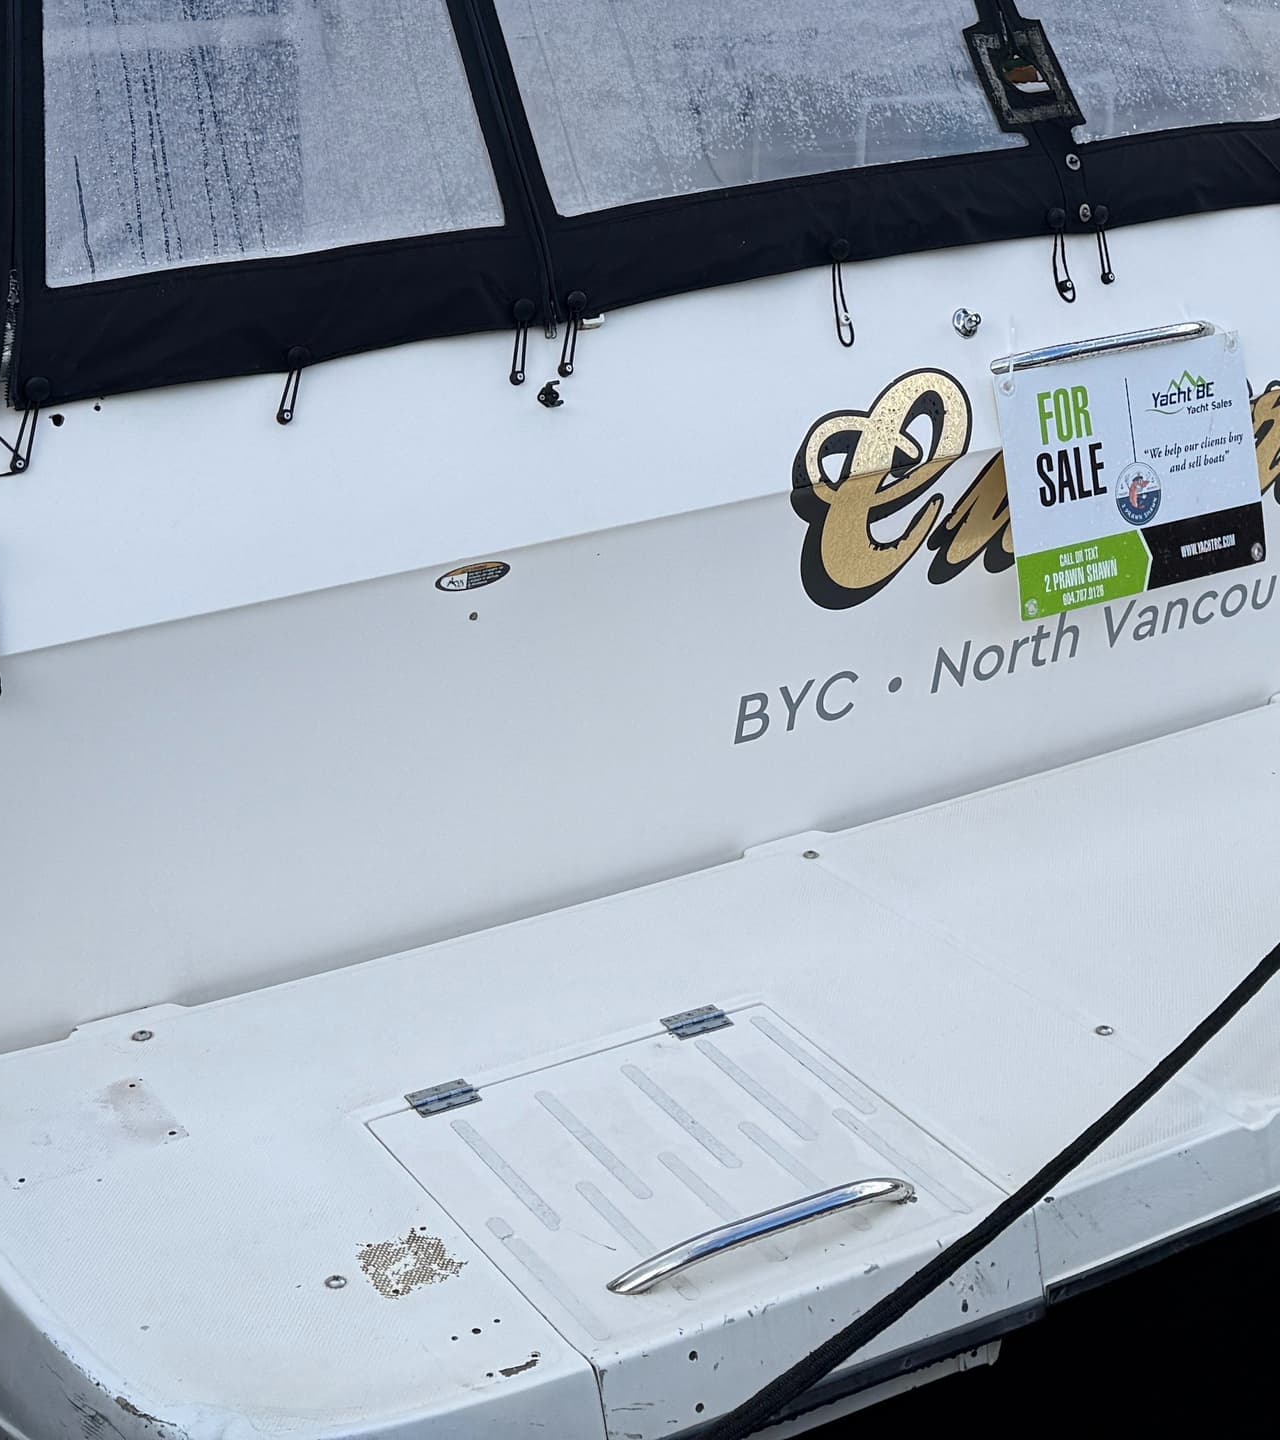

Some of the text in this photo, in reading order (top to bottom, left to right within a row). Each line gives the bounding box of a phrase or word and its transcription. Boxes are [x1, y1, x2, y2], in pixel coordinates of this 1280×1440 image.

[1152, 381, 1214, 408] Yacht BC
[1187, 399, 1233, 415] Yacht Sales
[1037, 385, 1093, 445] FOR
[1164, 442, 1182, 458] help
[1184, 442, 1199, 452] our
[1200, 436, 1227, 449] clients
[1228, 431, 1243, 445] buy
[1036, 442, 1108, 507] SALE
[1169, 459, 1186, 473] and
[1188, 456, 1202, 469] sell
[1060, 552, 1075, 567] CALL
[1084, 545, 1099, 561] TEXT
[1044, 558, 1118, 593] 2 PRAWN SHAWN
[734, 670, 858, 745] BYC
[932, 610, 1080, 694] North
